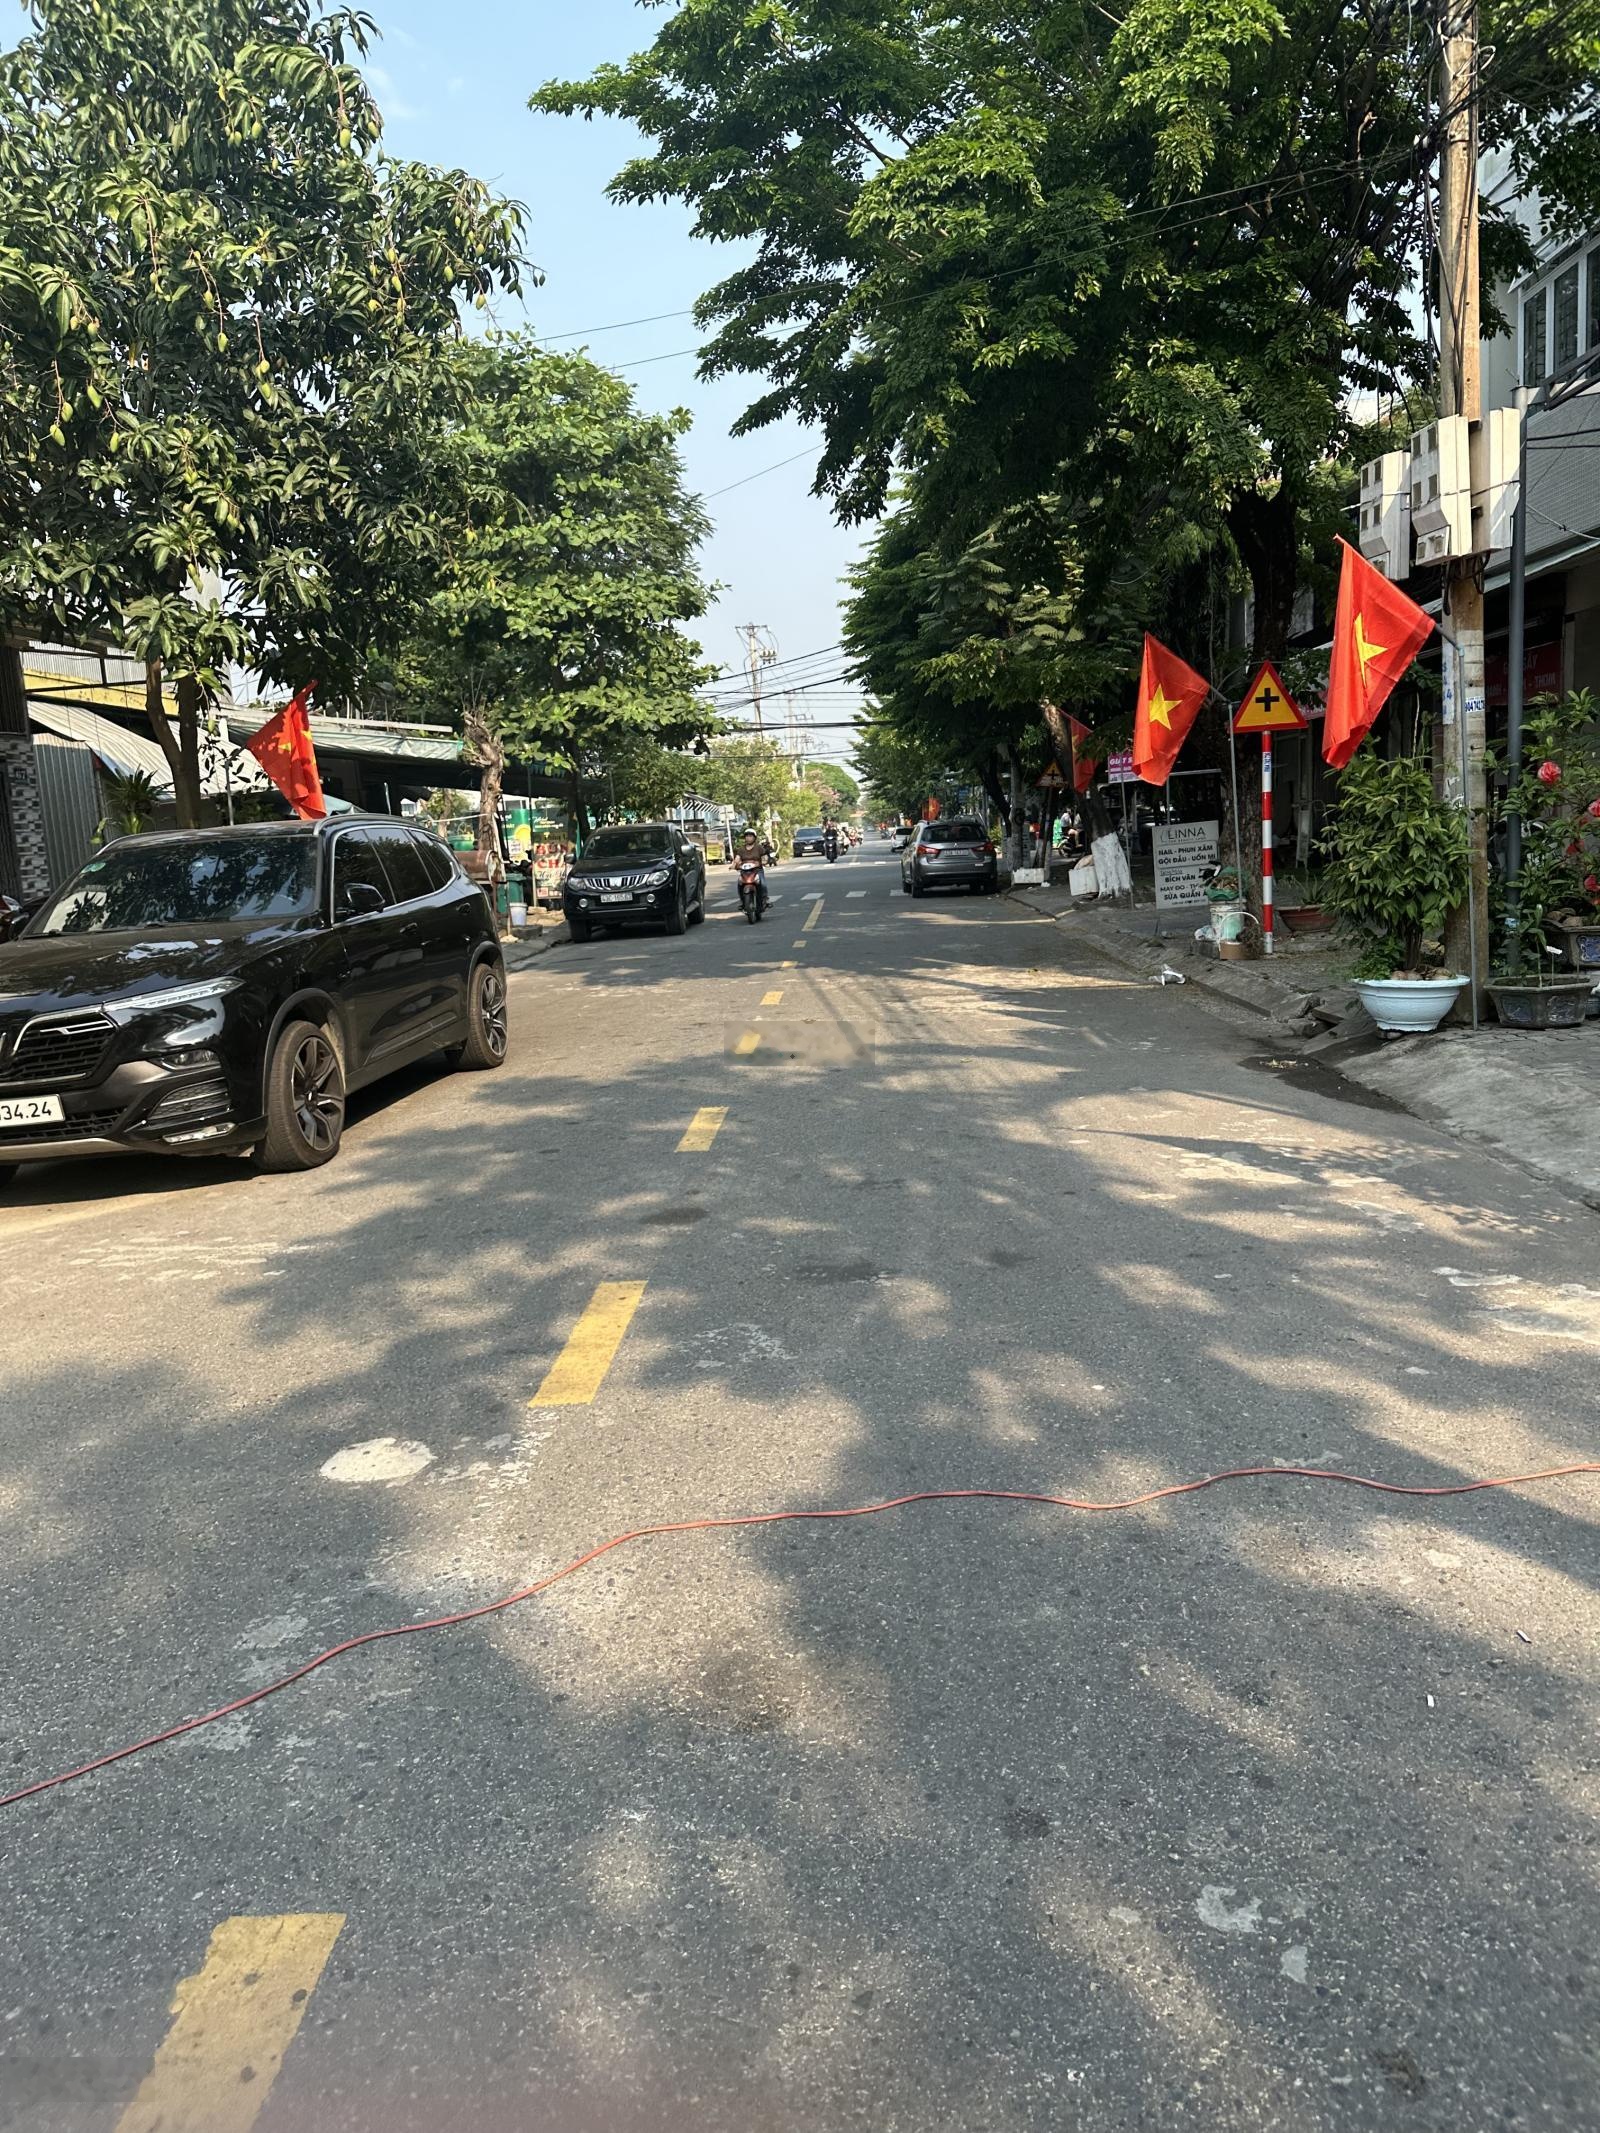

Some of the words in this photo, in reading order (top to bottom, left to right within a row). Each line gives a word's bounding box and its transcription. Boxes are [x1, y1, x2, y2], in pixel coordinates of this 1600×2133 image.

[1168, 827, 1206, 839] LINNA
[1178, 846, 1196, 854] PHUN
[0, 1101, 52, 1120] 34.24
